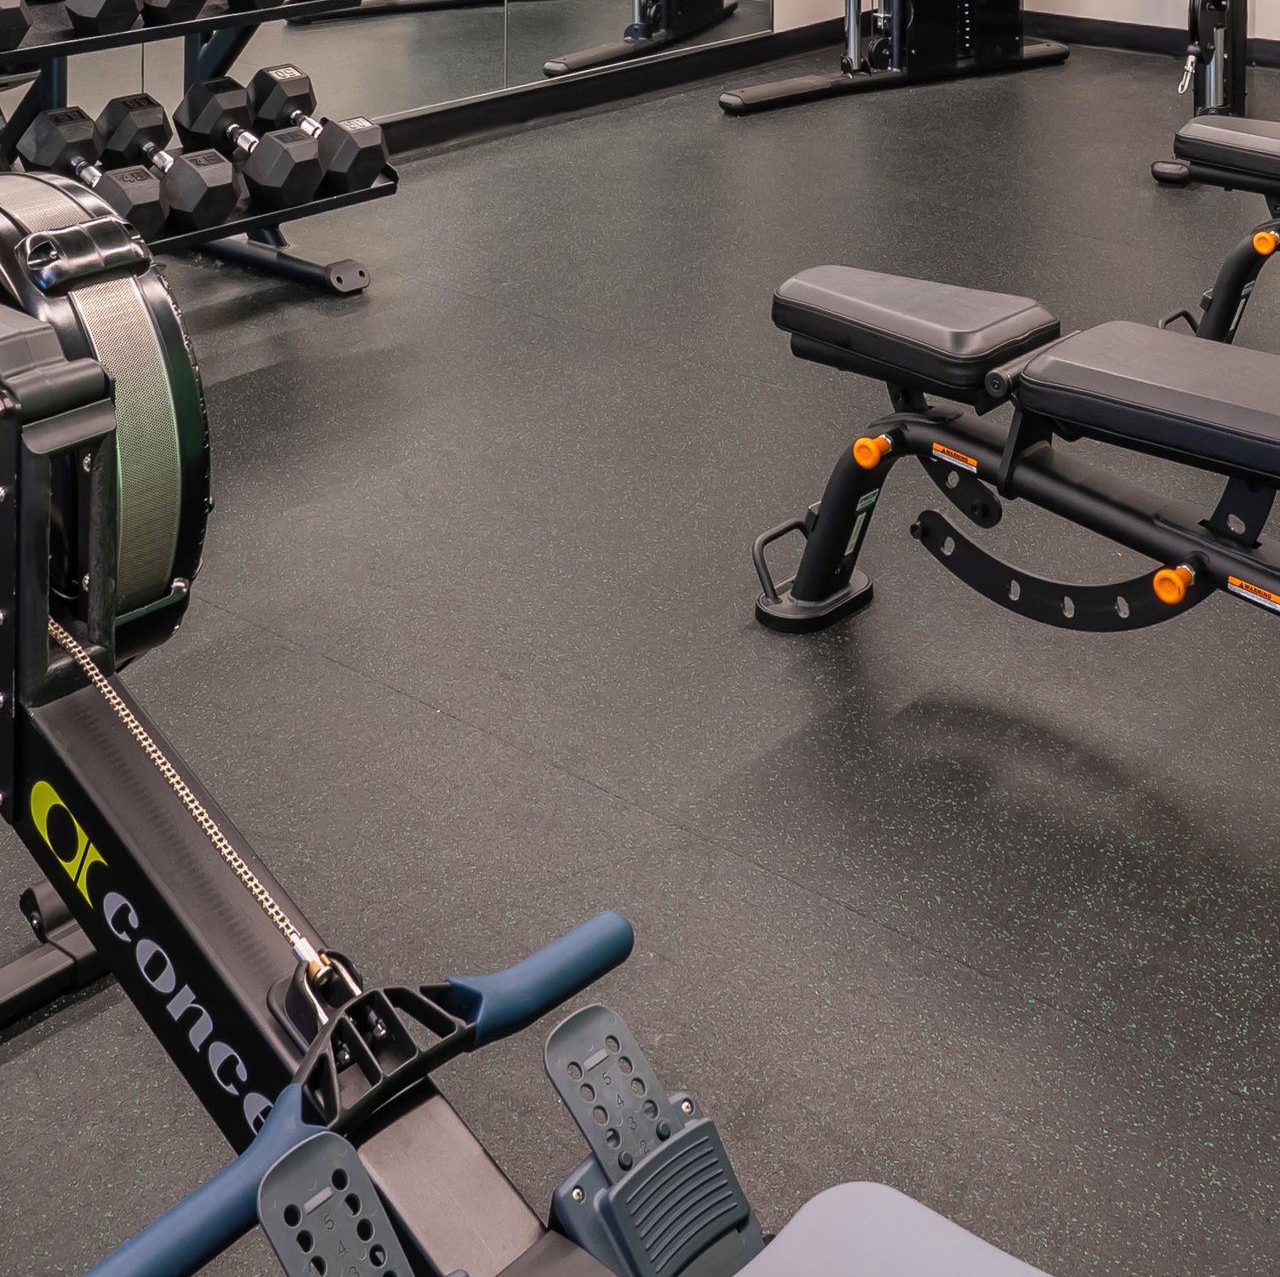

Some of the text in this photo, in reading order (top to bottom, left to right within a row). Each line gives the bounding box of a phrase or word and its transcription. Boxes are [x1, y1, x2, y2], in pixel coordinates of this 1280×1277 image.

[601, 1070, 613, 1086] 5
[615, 1092, 626, 1108] 4
[626, 1115, 638, 1131] 3
[323, 1213, 336, 1231] 5
[336, 1239, 349, 1258] 4
